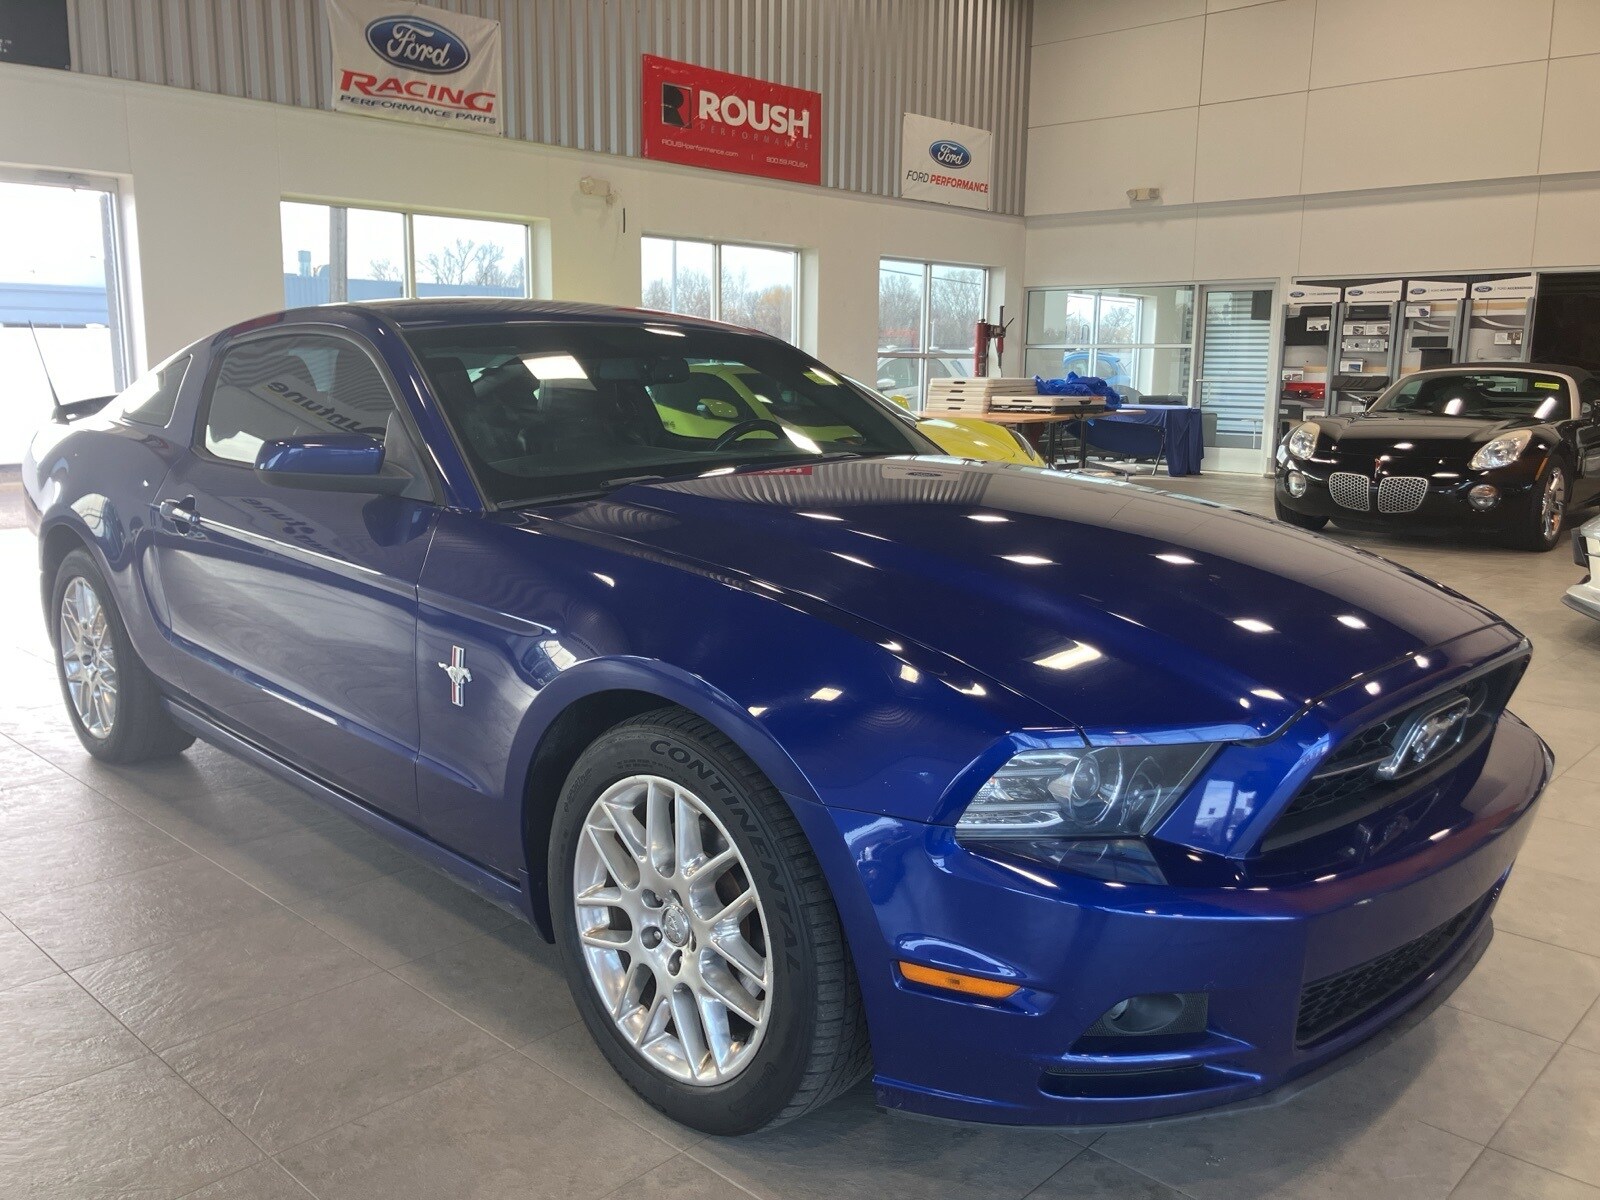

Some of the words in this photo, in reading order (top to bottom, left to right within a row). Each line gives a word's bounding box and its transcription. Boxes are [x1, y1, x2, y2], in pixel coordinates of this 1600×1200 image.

[387, 23, 450, 67] Ford
[340, 69, 496, 113] RACING
[340, 94, 450, 119] PERFORMANCE
[455, 112, 496, 124] PARTS
[699, 90, 810, 139] ROUSH
[700, 123, 809, 150] PERFORMANCE
[937, 143, 963, 165] Ford
[906, 170, 929, 183] FORD
[930, 174, 988, 193] PERFORMANCE
[650, 740, 800, 973] CONTINENTAL
